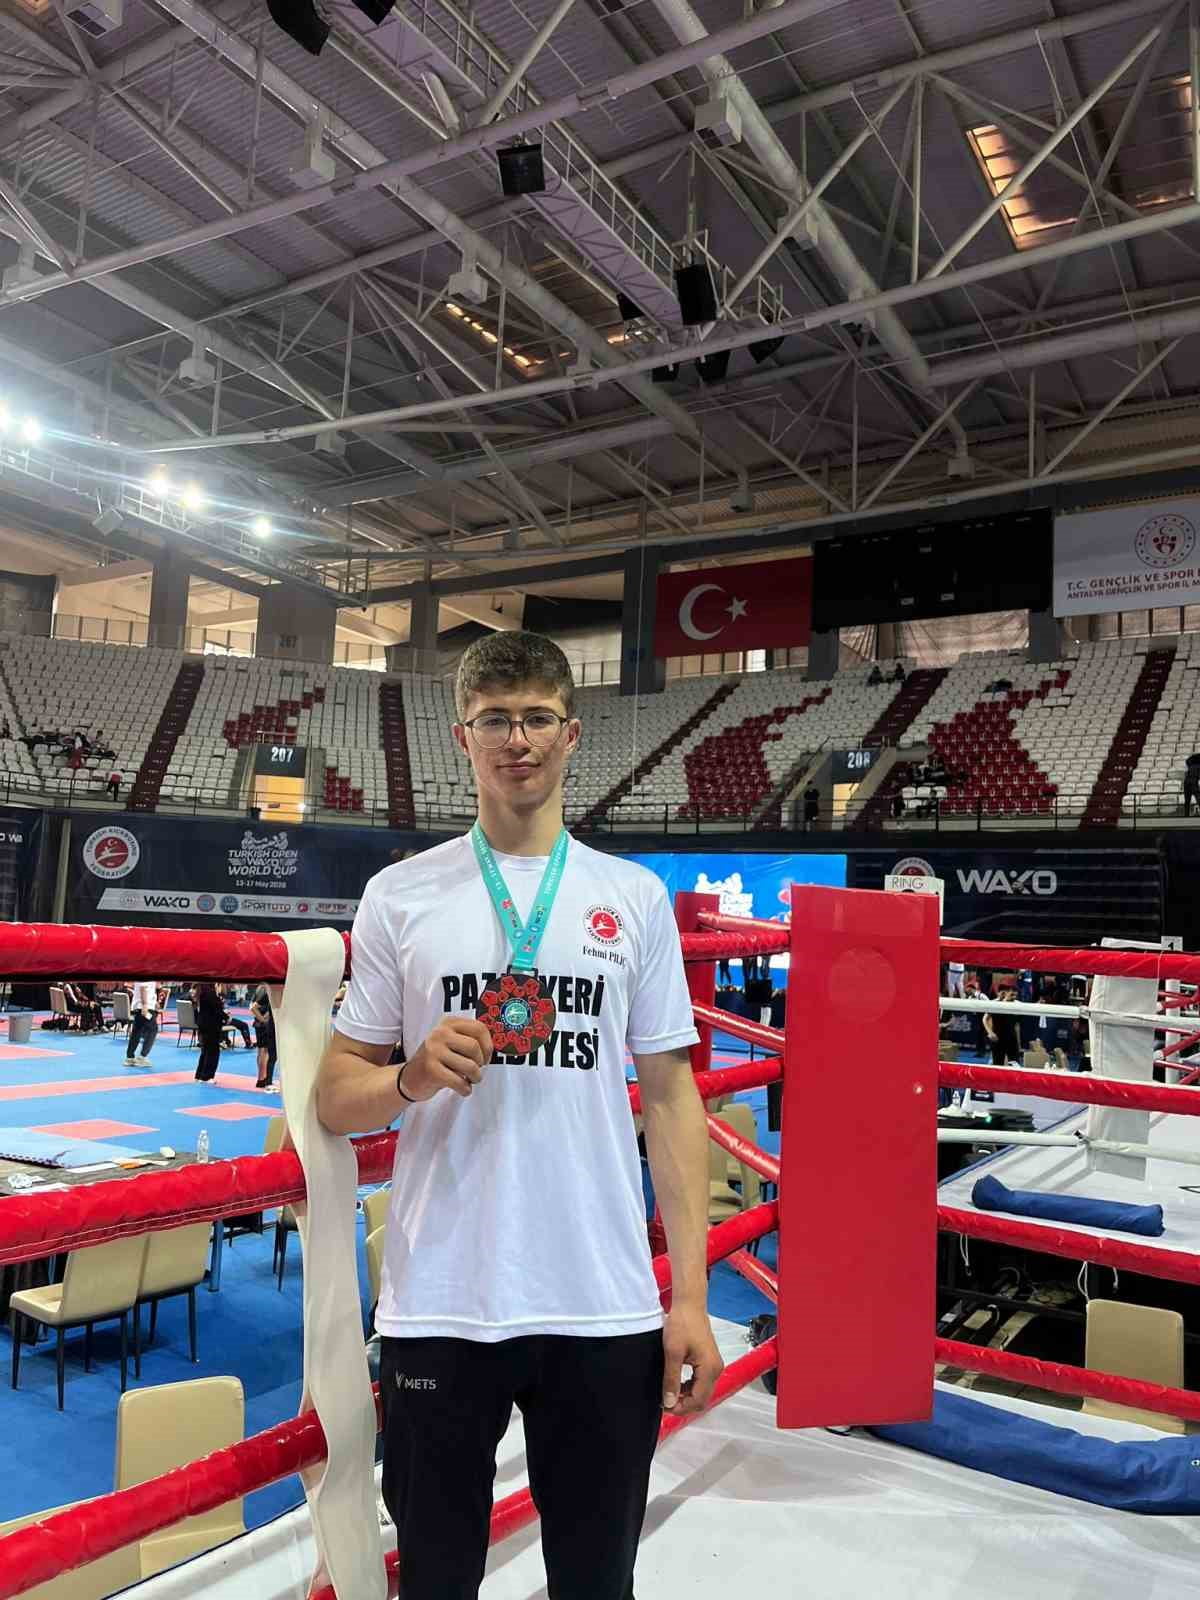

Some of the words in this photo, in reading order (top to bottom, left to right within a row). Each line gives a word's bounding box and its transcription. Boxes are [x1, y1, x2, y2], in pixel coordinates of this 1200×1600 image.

[1067, 582, 1086, 591] T.C.
[1090, 575, 1140, 590] GENÇLİK
[1145, 573, 1158, 582] VE
[1163, 568, 1194, 580] SPOR
[1141, 583, 1155, 592] VE
[1157, 580, 1180, 591] SPOR
[271, 746, 293, 762] 207
[228, 849, 270, 857] TURKISH
[271, 849, 298, 857] OPEN
[228, 866, 271, 876] WORLD
[273, 866, 297, 876] CUP
[892, 877, 924, 889] RING
[956, 869, 1057, 895] WAKO
[143, 895, 190, 908] WAKO
[405, 1378, 437, 1390] METS
